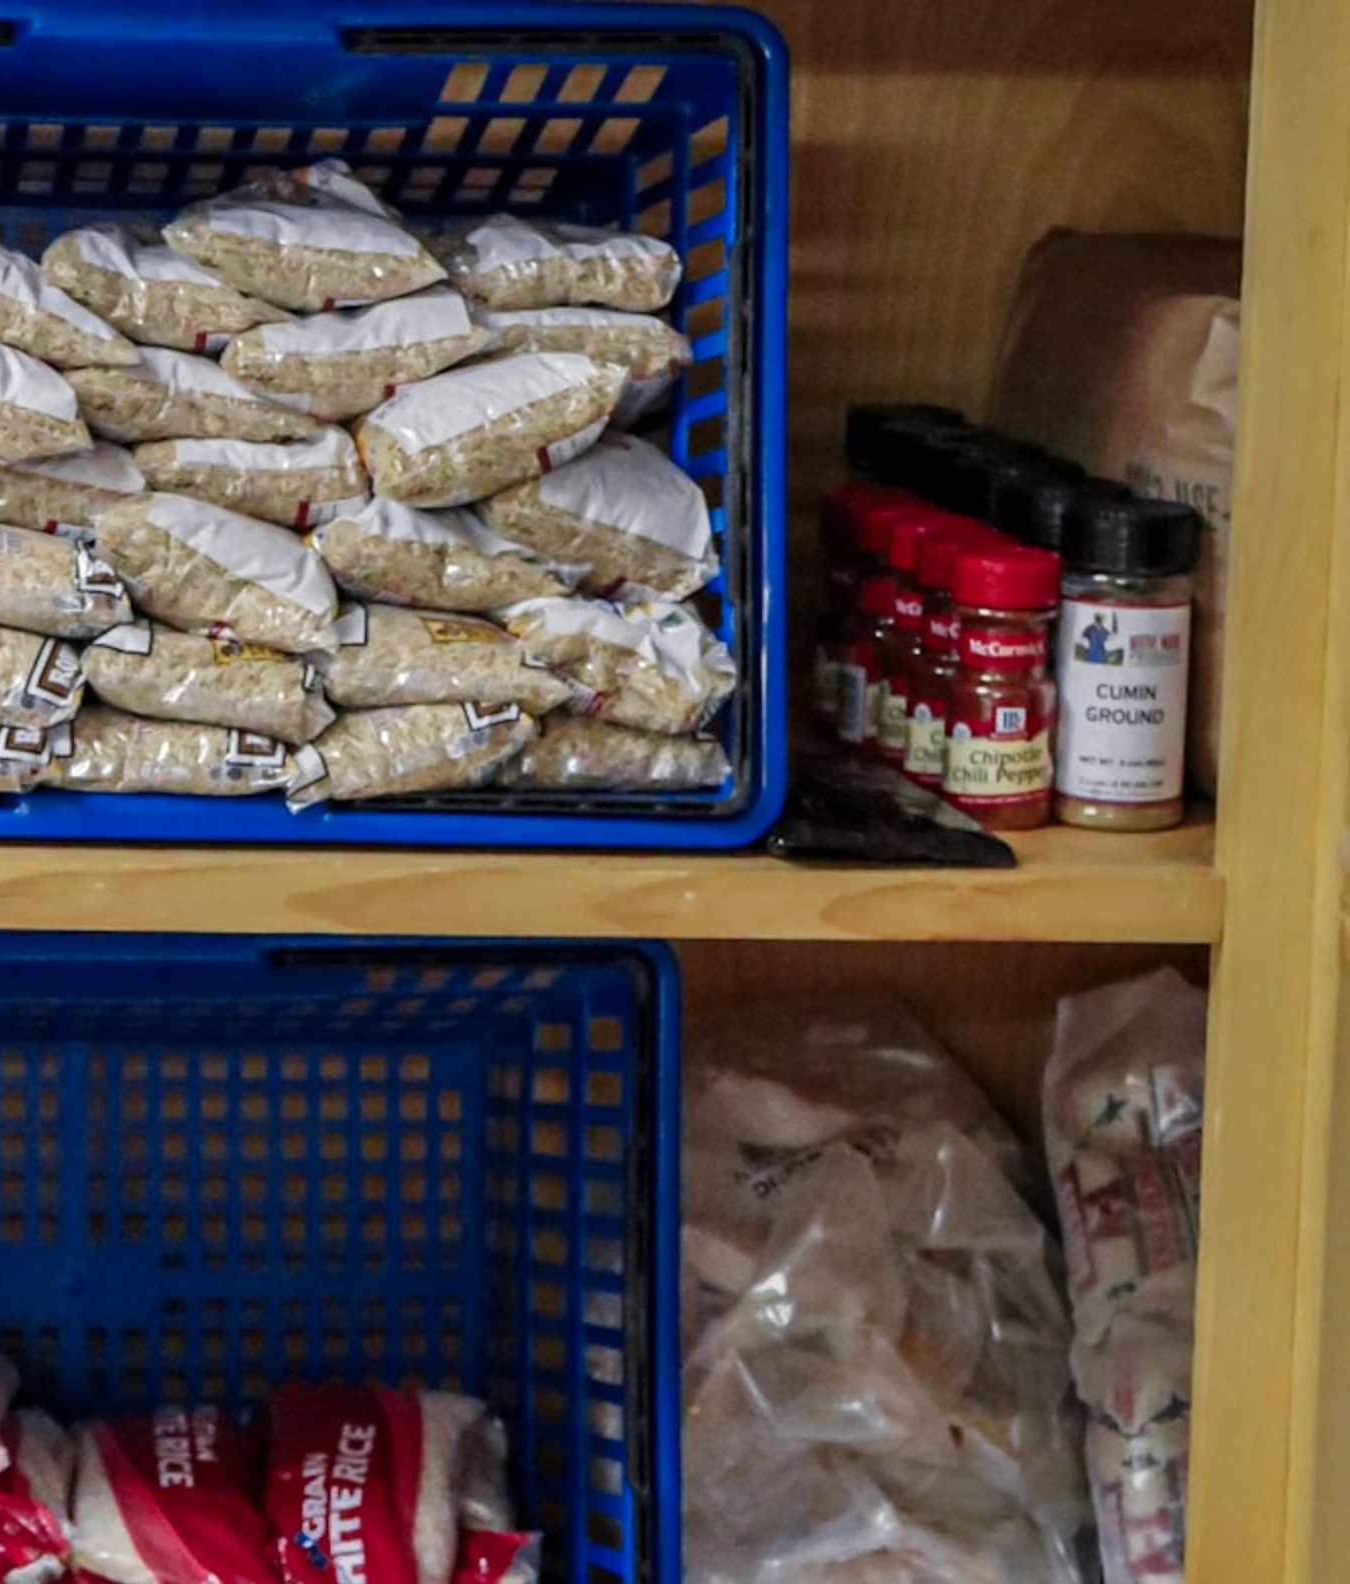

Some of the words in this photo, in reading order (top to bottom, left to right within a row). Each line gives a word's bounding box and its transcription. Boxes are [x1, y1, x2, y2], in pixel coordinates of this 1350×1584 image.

[1096, 683, 1157, 701] CUMIN
[1085, 707, 1165, 725] GROUND
[952, 766, 989, 783] Chili
[332, 1422, 377, 1485] RICE
[302, 1451, 331, 1541] GRAIN
[329, 1485, 368, 1584] HITE
